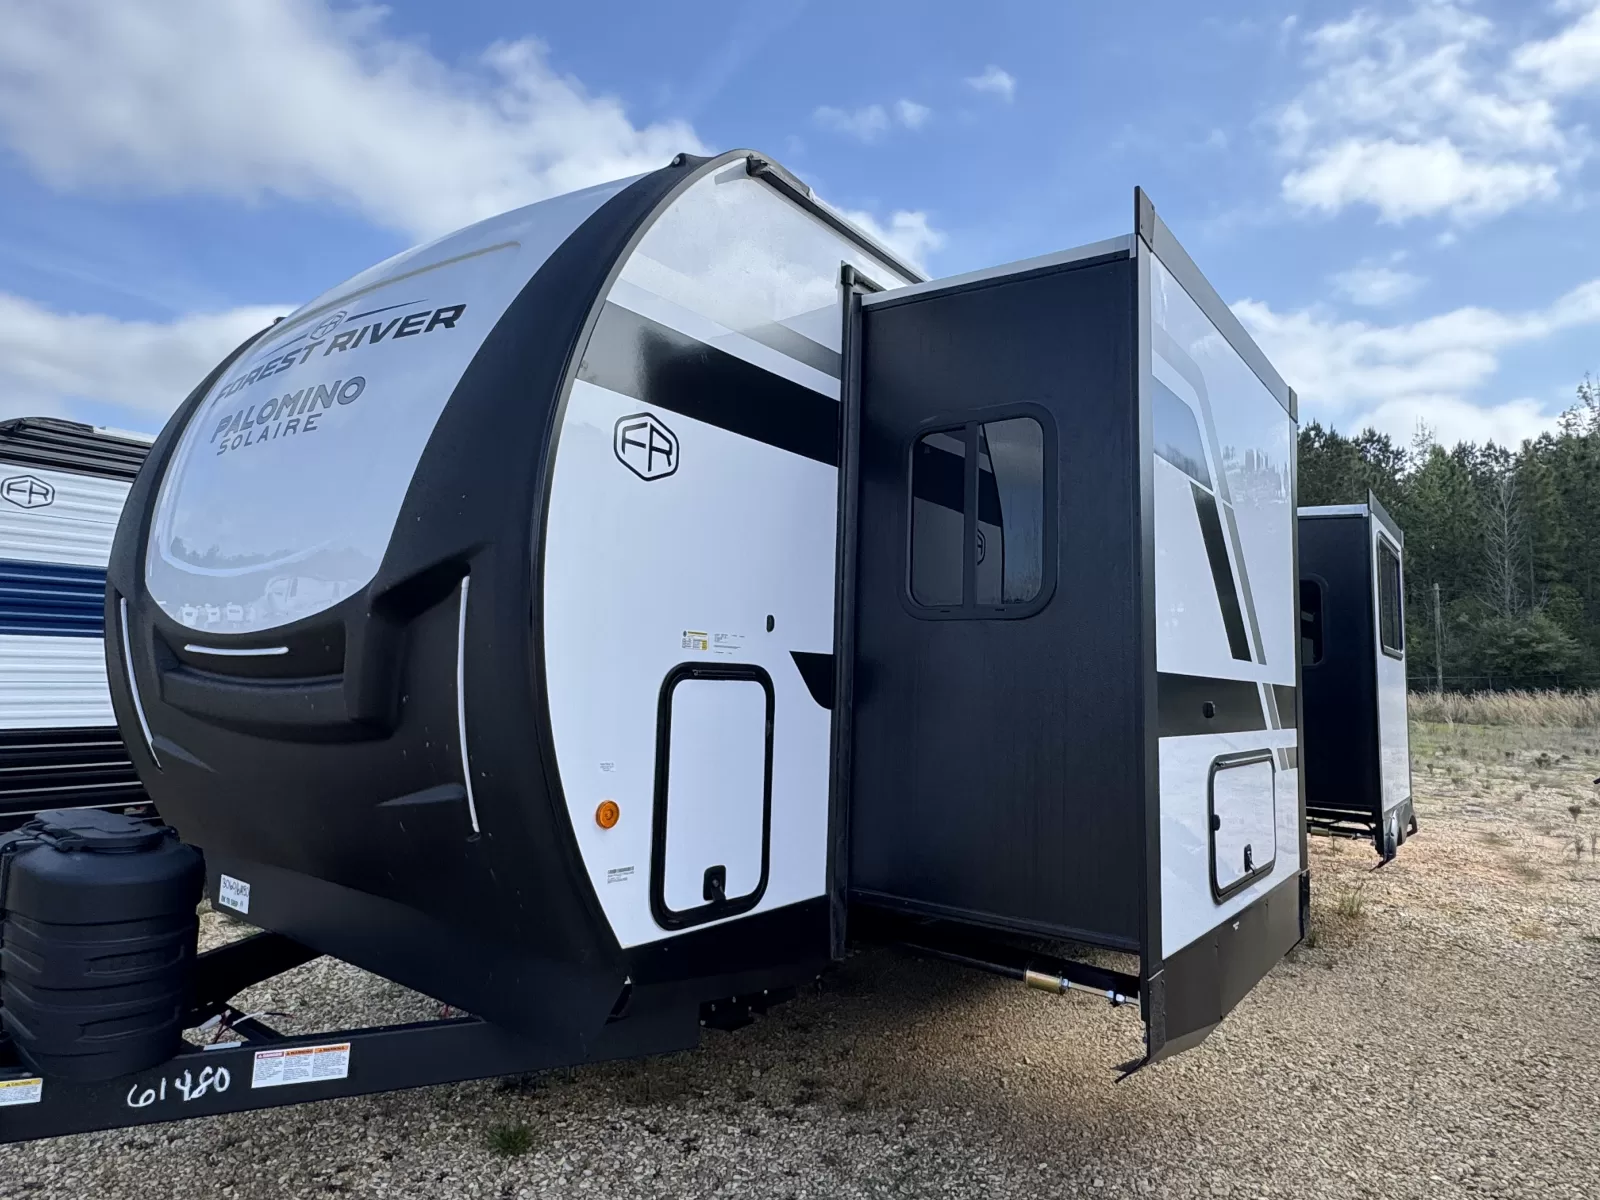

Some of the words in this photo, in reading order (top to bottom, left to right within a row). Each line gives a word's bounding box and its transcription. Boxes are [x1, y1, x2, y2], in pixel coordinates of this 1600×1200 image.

[211, 339, 325, 407] FOREST
[323, 304, 466, 356] RIVER
[210, 376, 366, 443] PALOMINO
[217, 413, 322, 455] SOLAIRE
